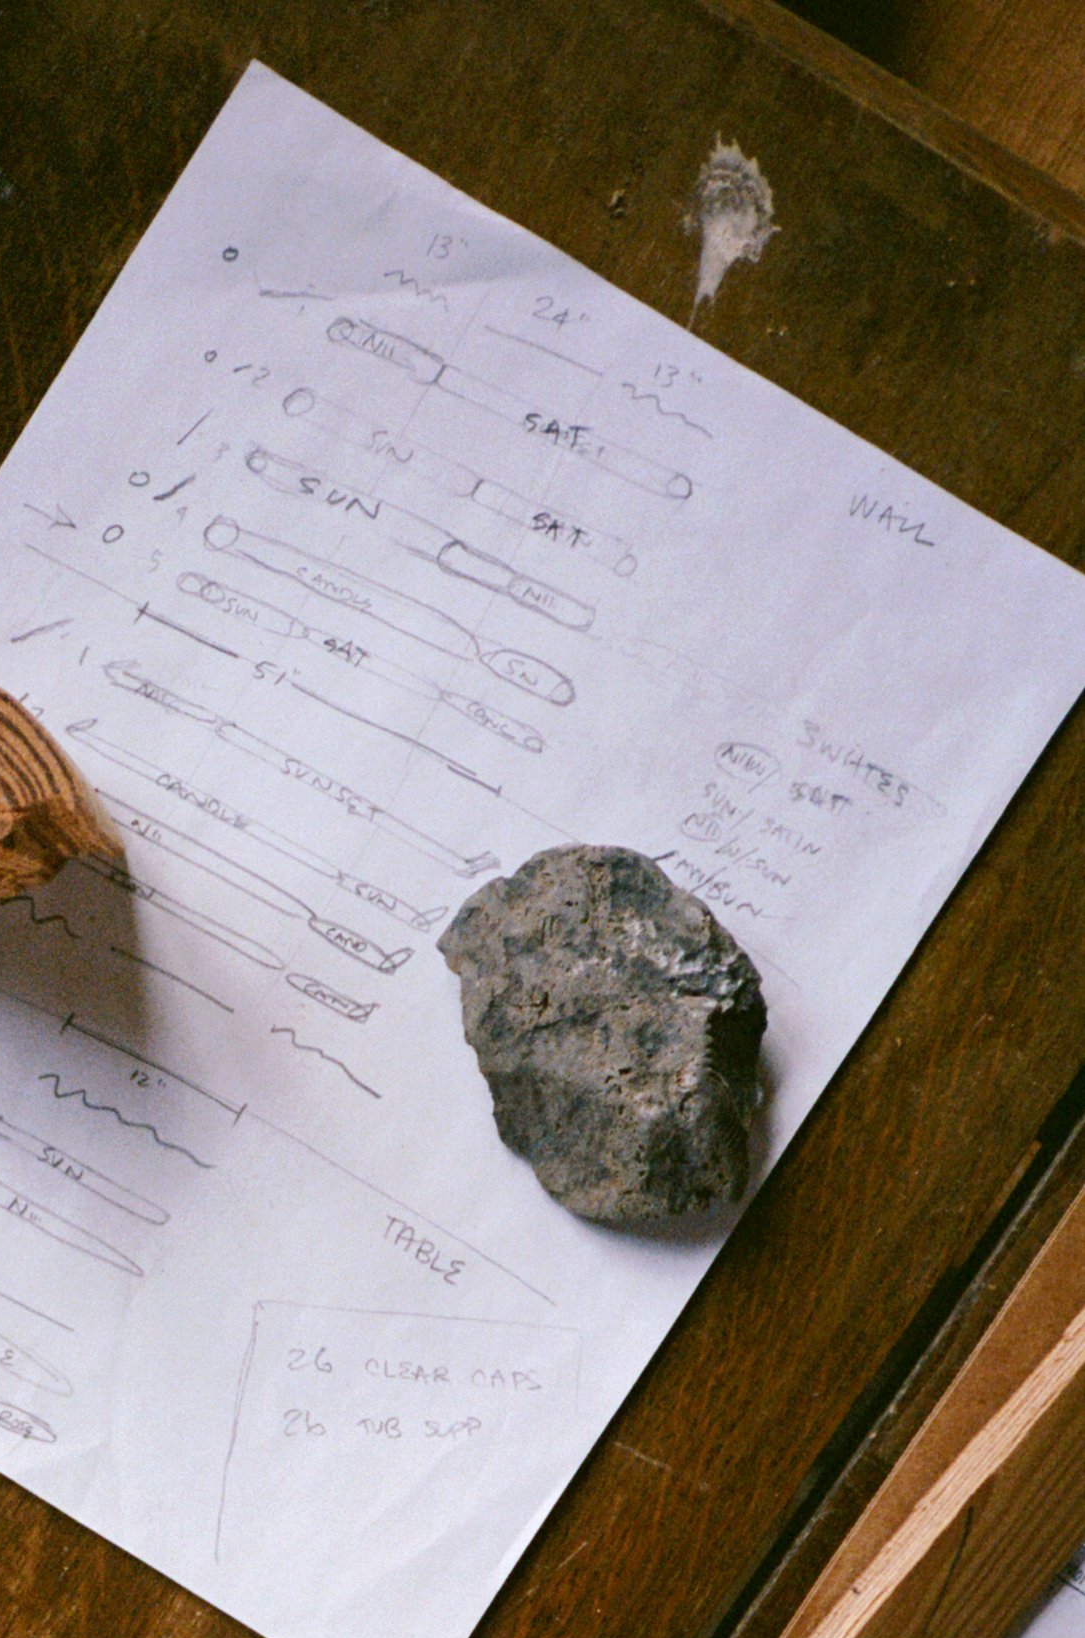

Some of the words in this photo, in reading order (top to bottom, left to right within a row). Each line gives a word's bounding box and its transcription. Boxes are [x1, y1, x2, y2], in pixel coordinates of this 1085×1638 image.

[299, 477, 382, 520] SUN
[35, 1145, 84, 1182] SUN
[384, 1213, 466, 1286] TABLE
[287, 1346, 333, 1374] 26
[364, 1356, 450, 1384] CLEAR
